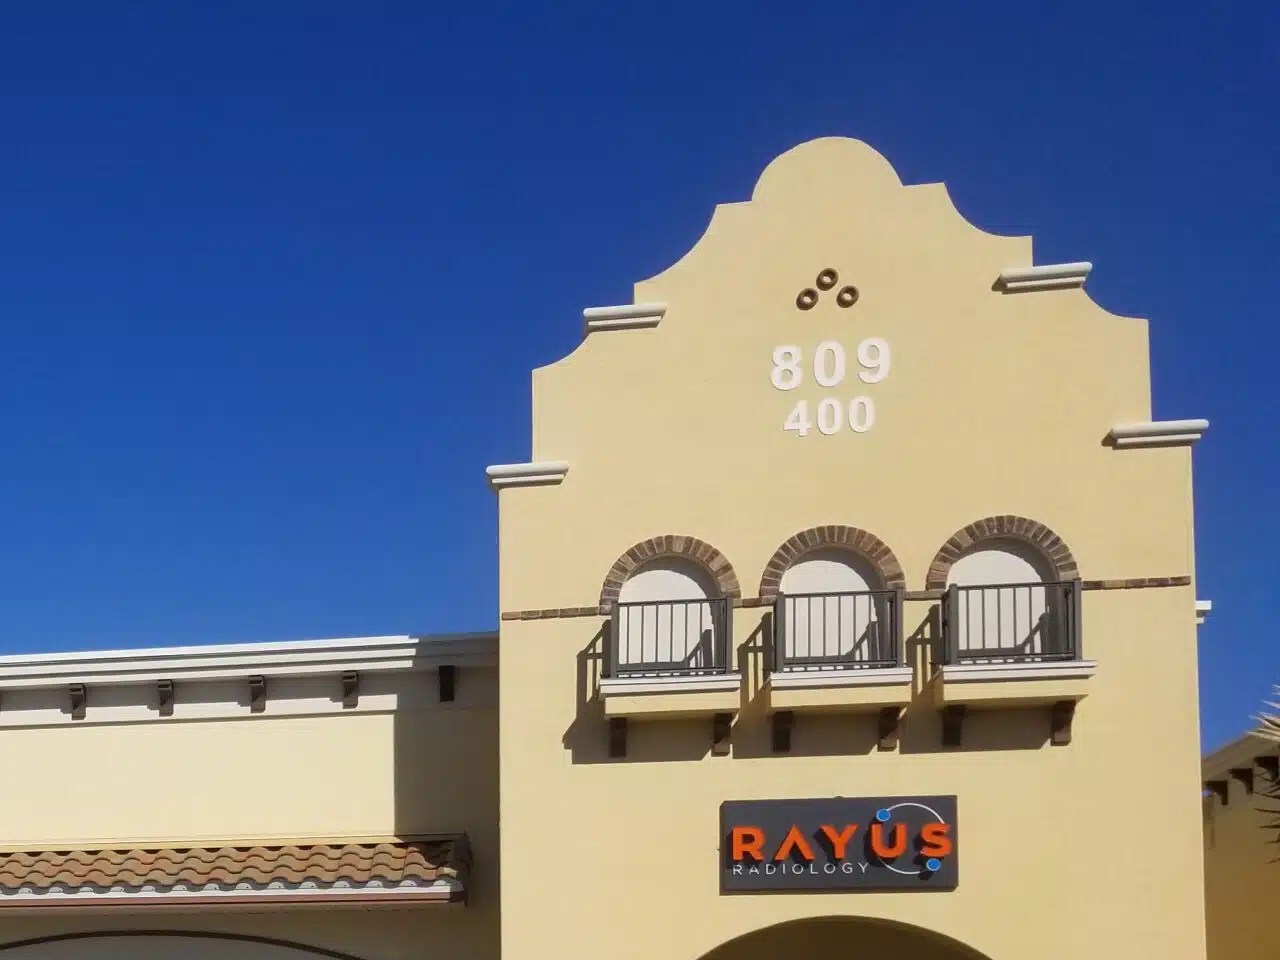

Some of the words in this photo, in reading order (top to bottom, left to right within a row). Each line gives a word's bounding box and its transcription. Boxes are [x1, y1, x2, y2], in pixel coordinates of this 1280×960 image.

[771, 337, 892, 391] 809
[783, 396, 876, 437] 400
[731, 822, 952, 861] RAYUS
[732, 862, 869, 876] RADIOLOGY
